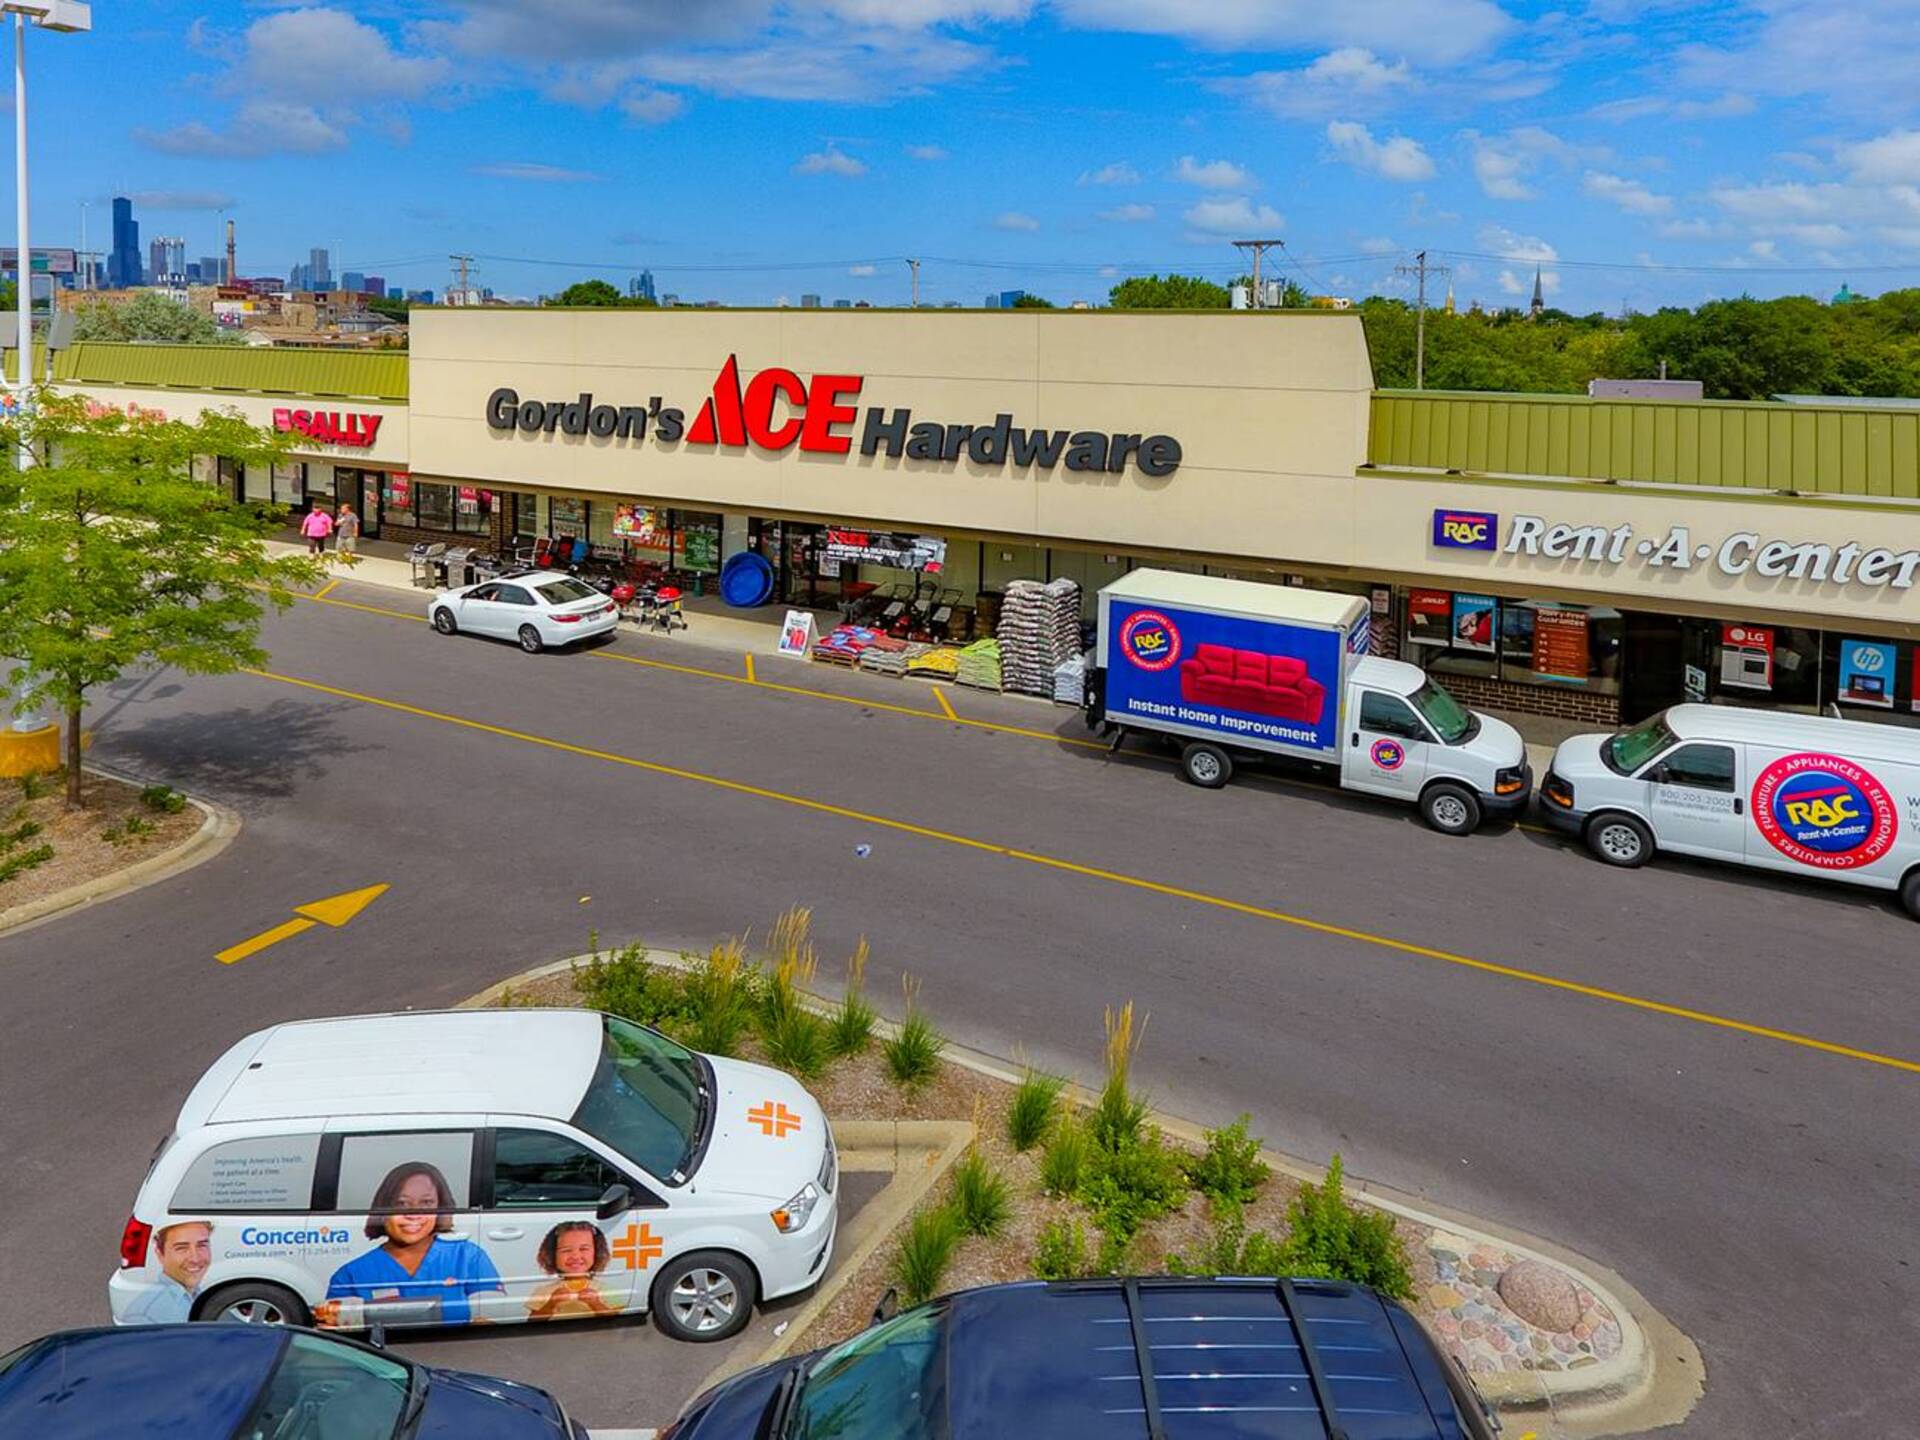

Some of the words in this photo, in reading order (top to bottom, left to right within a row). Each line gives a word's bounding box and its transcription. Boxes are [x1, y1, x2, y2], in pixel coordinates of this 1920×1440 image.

[292, 410, 383, 447] SALLY
[486, 388, 685, 442] Gordon's
[685, 353, 864, 454] ACE
[860, 407, 1182, 477] Hardware
[1443, 521, 1488, 544] RAC
[1457, 596, 1494, 607] SAMSUNG
[1134, 631, 1166, 649] RAC
[1747, 631, 1765, 642] LG
[1856, 647, 1882, 671] hp
[1128, 698, 1176, 717] Instant
[1179, 708, 1218, 725] Home
[1220, 714, 1318, 744] Improvement
[1785, 757, 1861, 782] APPLIANCES
[1757, 773, 1778, 831] FURNITURE
[1785, 794, 1859, 828] RAC
[1866, 788, 1893, 857] ELECTRONICS
[1778, 837, 1855, 866] COMPUTERS
[241, 1226, 349, 1246] Concentra
